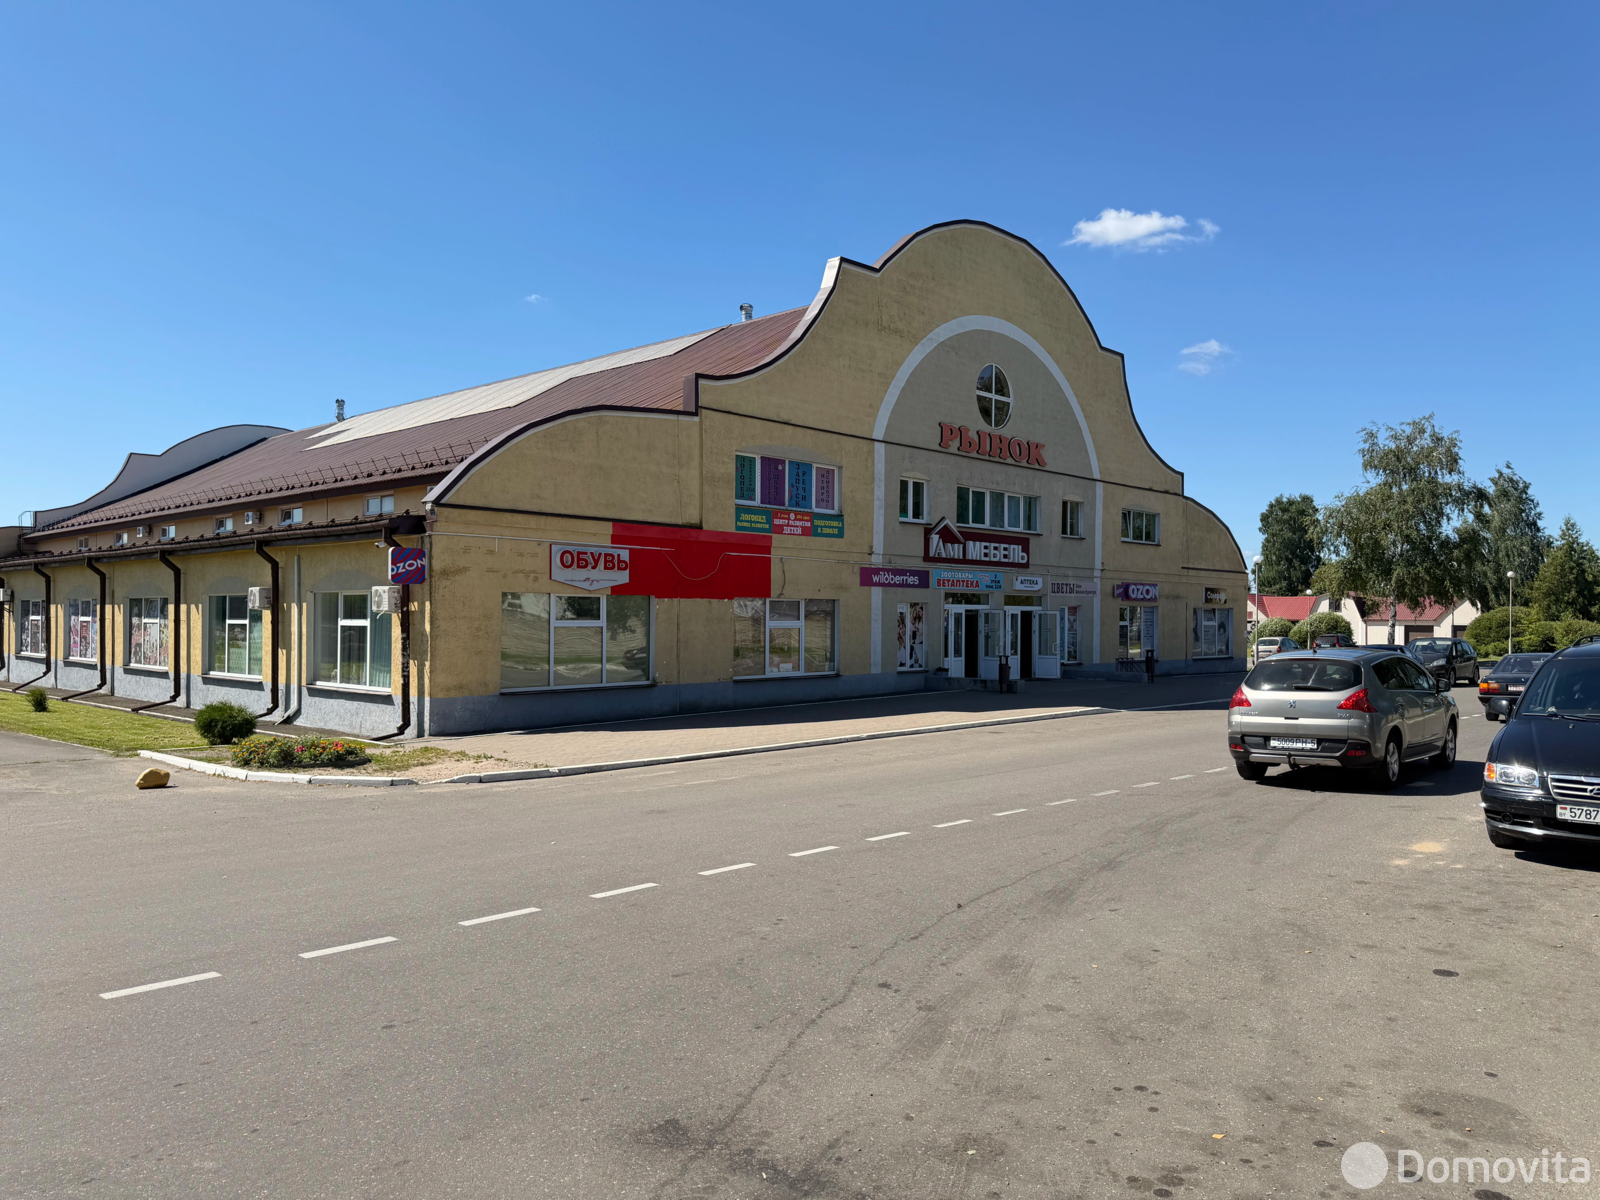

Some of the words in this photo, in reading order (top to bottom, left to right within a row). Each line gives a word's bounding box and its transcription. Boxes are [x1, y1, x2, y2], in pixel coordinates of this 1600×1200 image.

[939, 422, 1048, 467] РЫНОК
[740, 513, 767, 523] ЛОГОПЕД
[788, 519, 811, 527] РАЗВИТИЯ
[391, 557, 426, 575] OZON
[558, 549, 629, 572] ОБУВЬ
[872, 571, 919, 585] wildberries
[940, 571, 974, 580] ЗООТОВАРЫ
[1019, 578, 1039, 586] АПТЕКА
[936, 578, 980, 589] ВЕТАПТЕКА
[1051, 582, 1075, 595] ЦВЕТЫ
[1128, 584, 1159, 600] OZON
[1569, 807, 1599, 820] 5787
